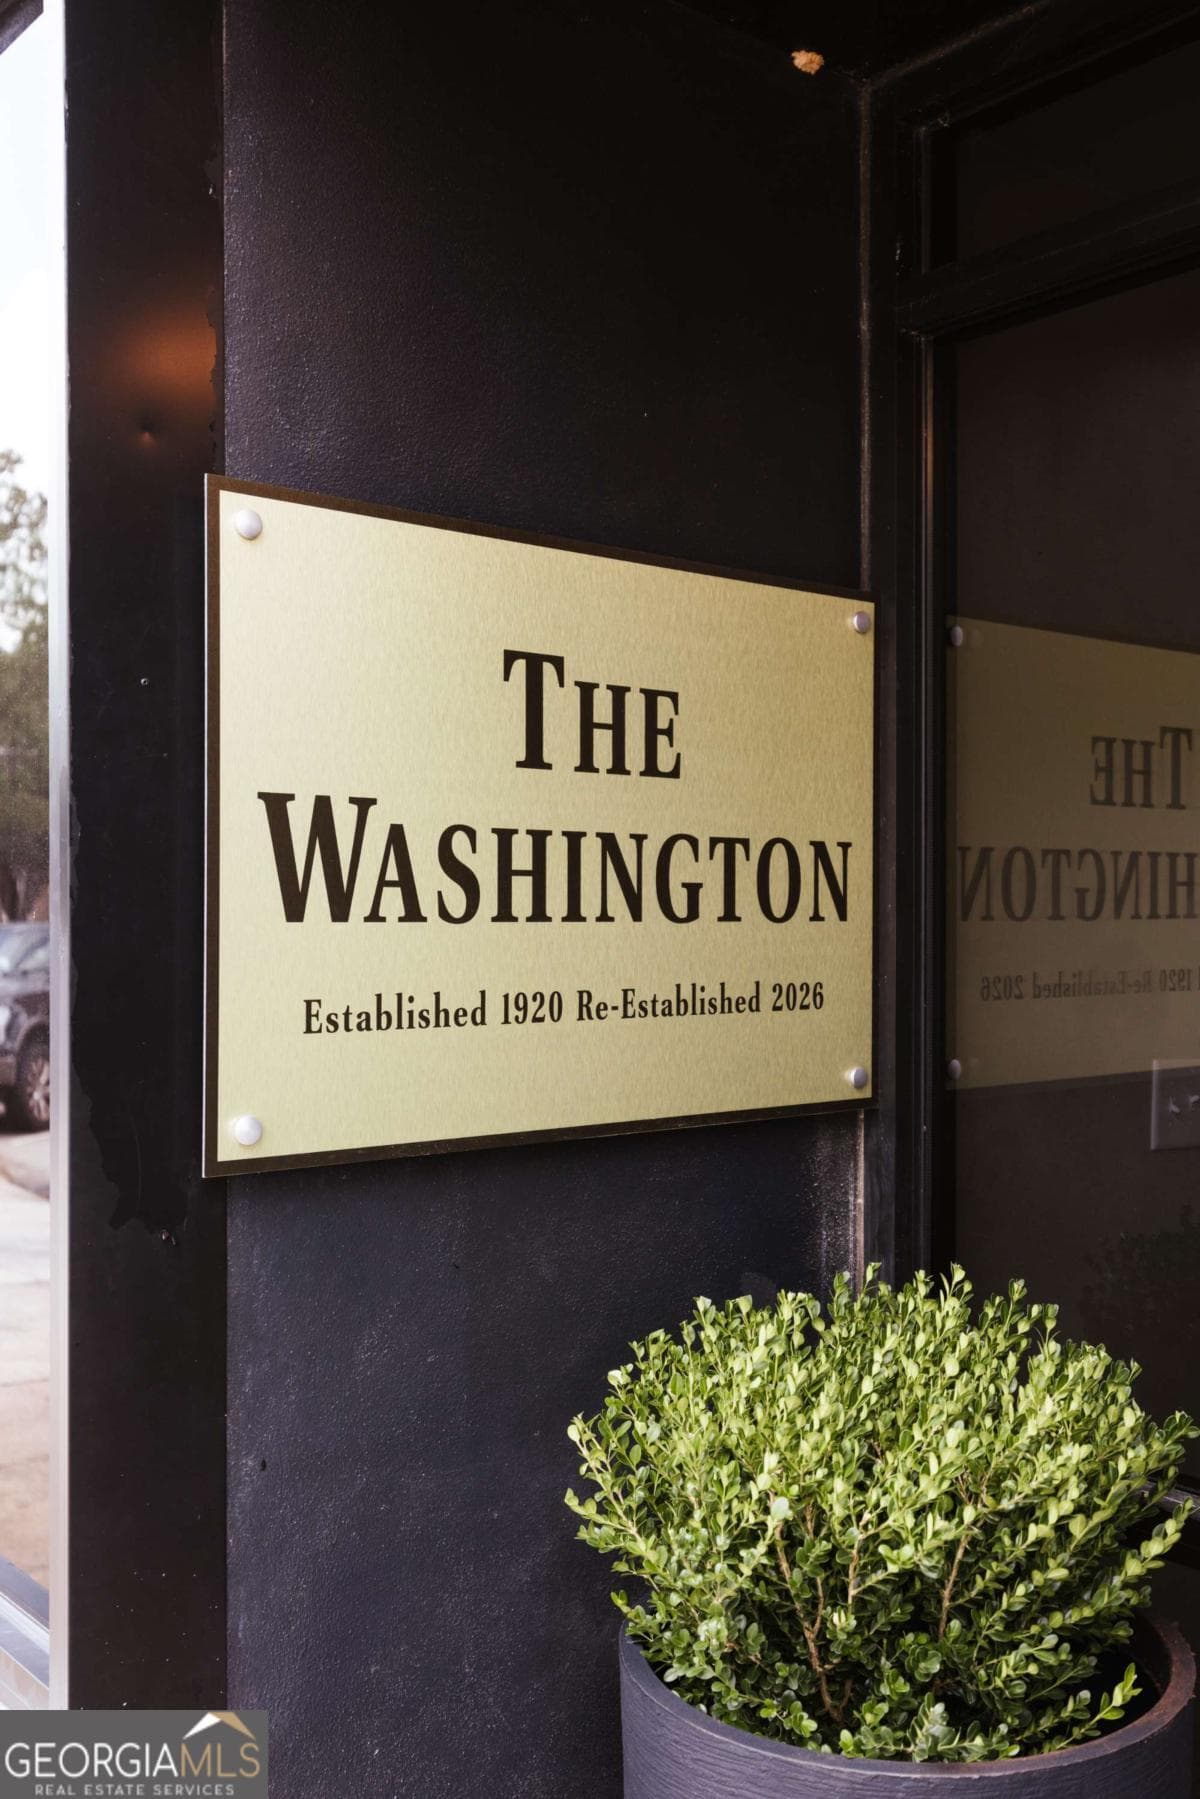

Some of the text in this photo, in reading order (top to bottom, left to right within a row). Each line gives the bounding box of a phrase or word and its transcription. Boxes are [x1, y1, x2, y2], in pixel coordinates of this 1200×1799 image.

[503, 649, 682, 779] THE
[257, 791, 853, 925] WASHINGTON
[302, 981, 825, 1035] Established 1920 Re-Established 2026
